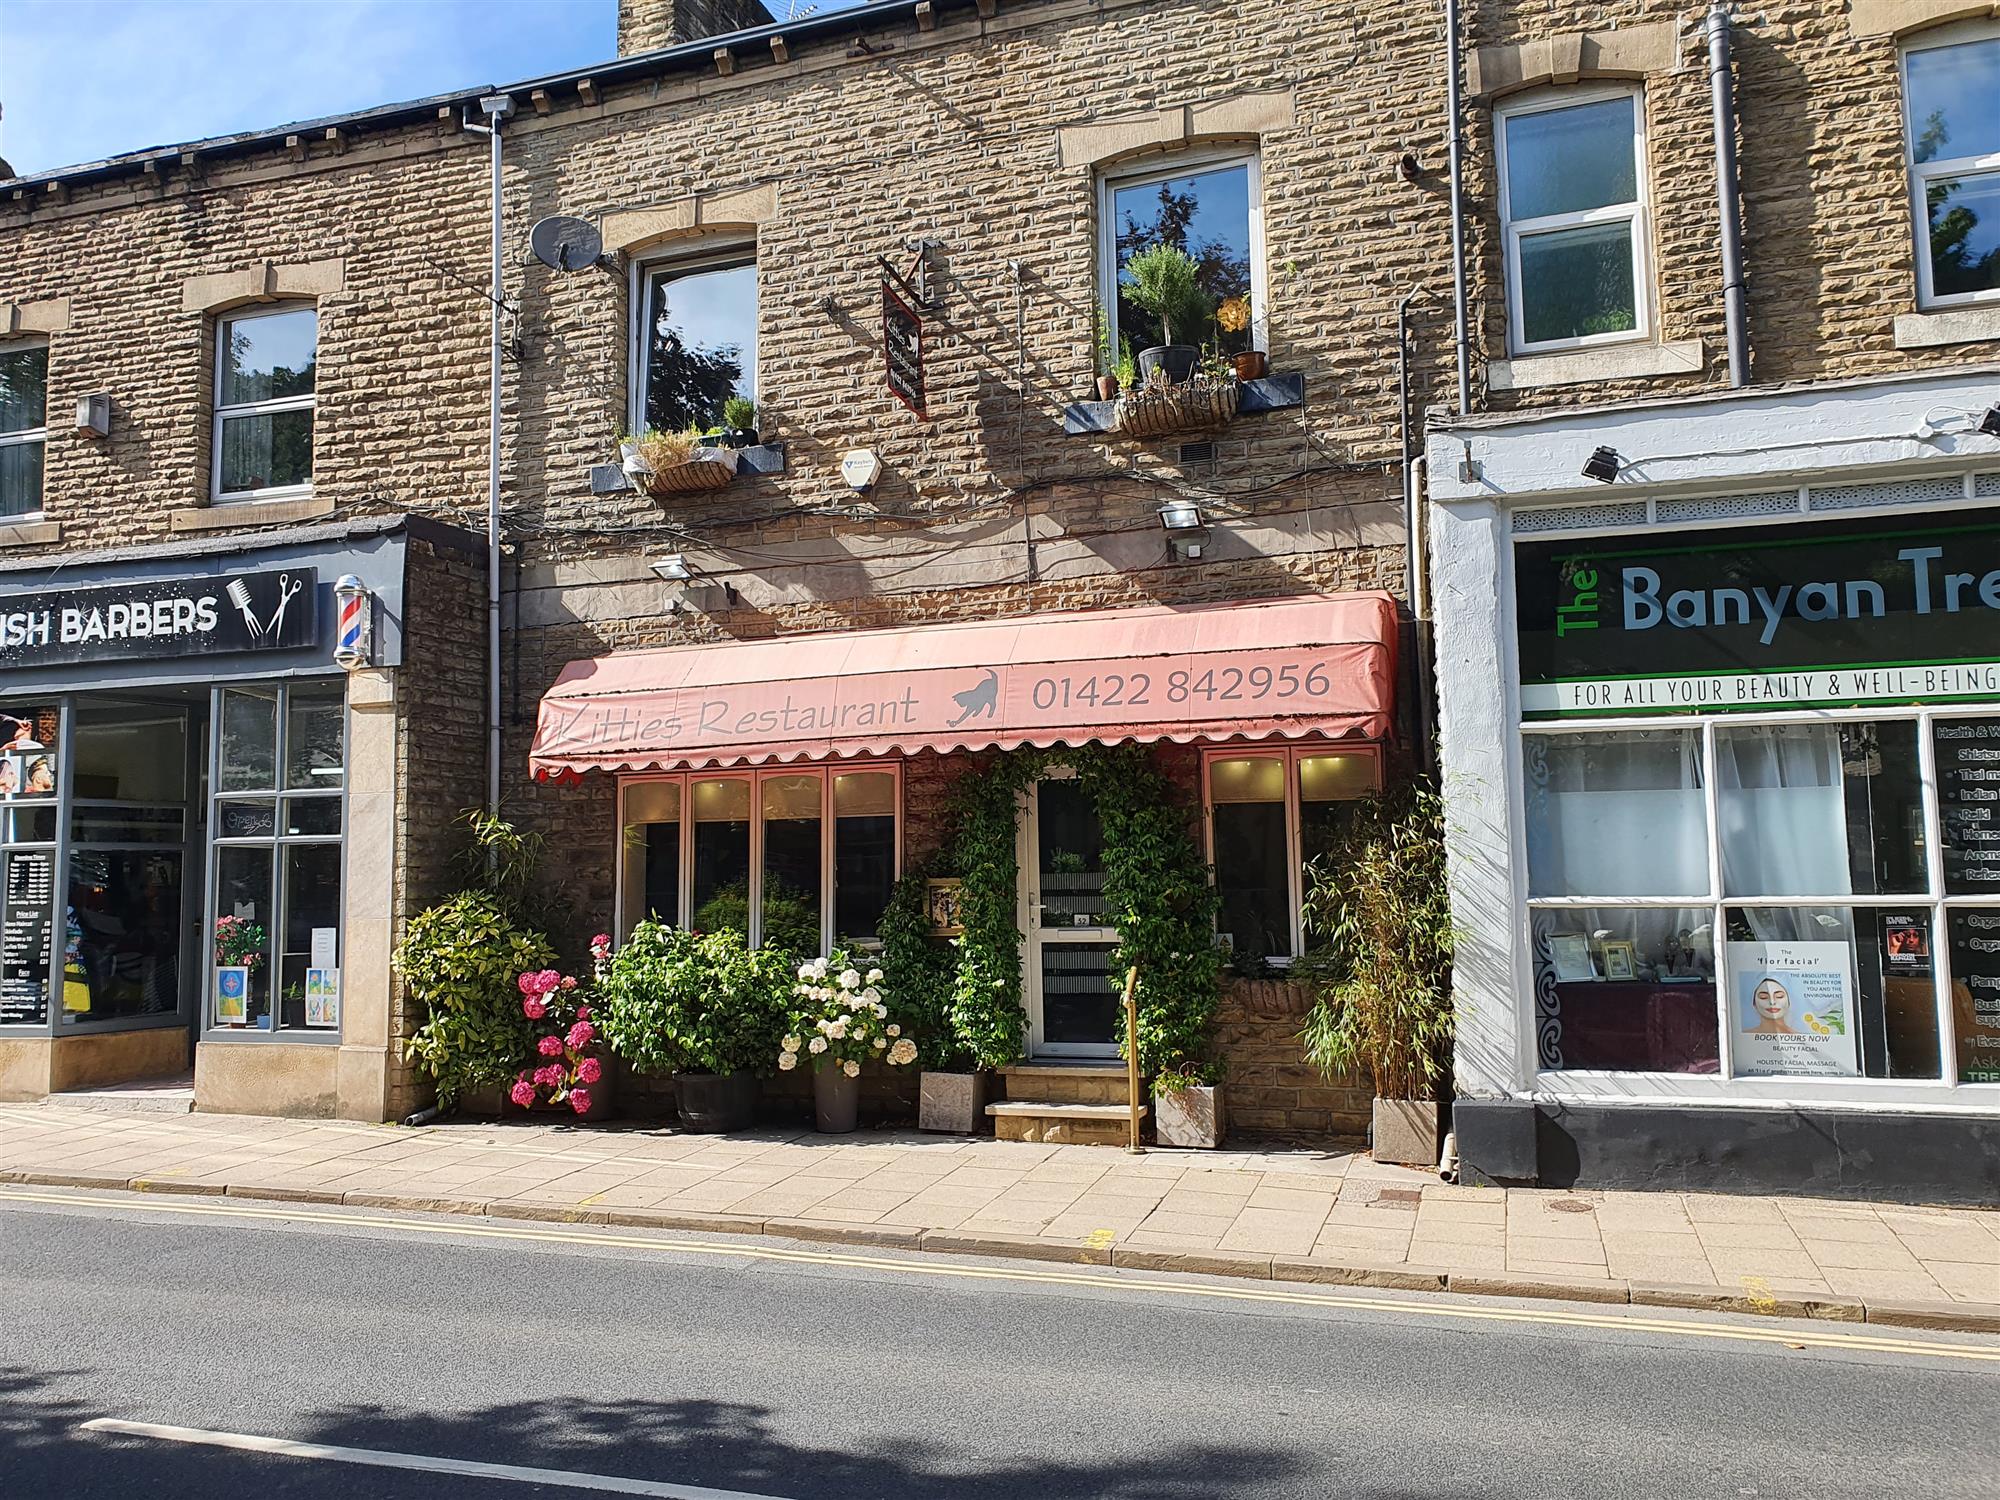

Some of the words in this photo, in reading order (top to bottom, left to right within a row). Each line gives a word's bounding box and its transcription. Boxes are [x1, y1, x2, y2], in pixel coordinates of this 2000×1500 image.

[60, 596, 218, 643] BARBERS
[1556, 567, 1599, 637] The
[1622, 566, 1886, 645] Banyan
[556, 703, 682, 746] Kitties
[698, 686, 919, 738] Restaurant
[1032, 672, 1151, 710] 01422
[1166, 662, 1331, 703] 842956
[1574, 684, 1611, 706] FOR
[1624, 682, 1656, 704] ALL
[1667, 679, 1722, 702] YOUR
[1737, 675, 1813, 700] BEAUTY
[1828, 674, 1840, 696] &
[1854, 667, 1996, 694] WELL-BEING
[1937, 725, 1975, 739] Health
[1960, 787, 1998, 801] Indian
